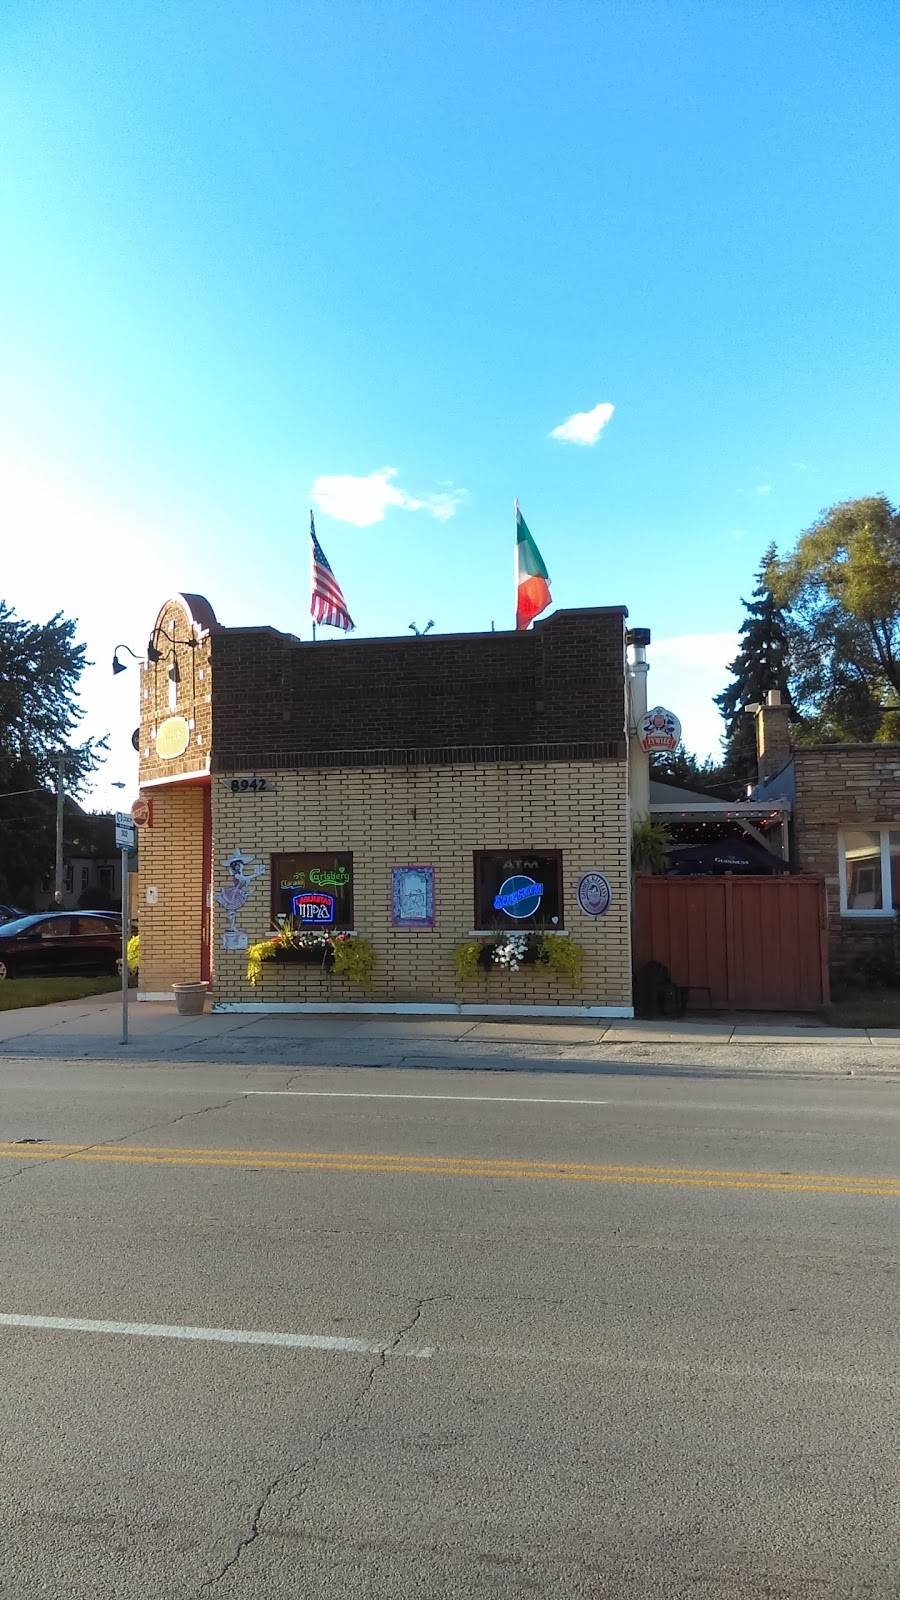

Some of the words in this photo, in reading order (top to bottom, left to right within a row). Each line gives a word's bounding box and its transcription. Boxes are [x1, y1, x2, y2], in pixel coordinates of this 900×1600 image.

[230, 779, 266, 791] 8942
[503, 860, 540, 869] ATM
[309, 868, 350, 886] Carlsberg
[298, 904, 331, 919] IPA
